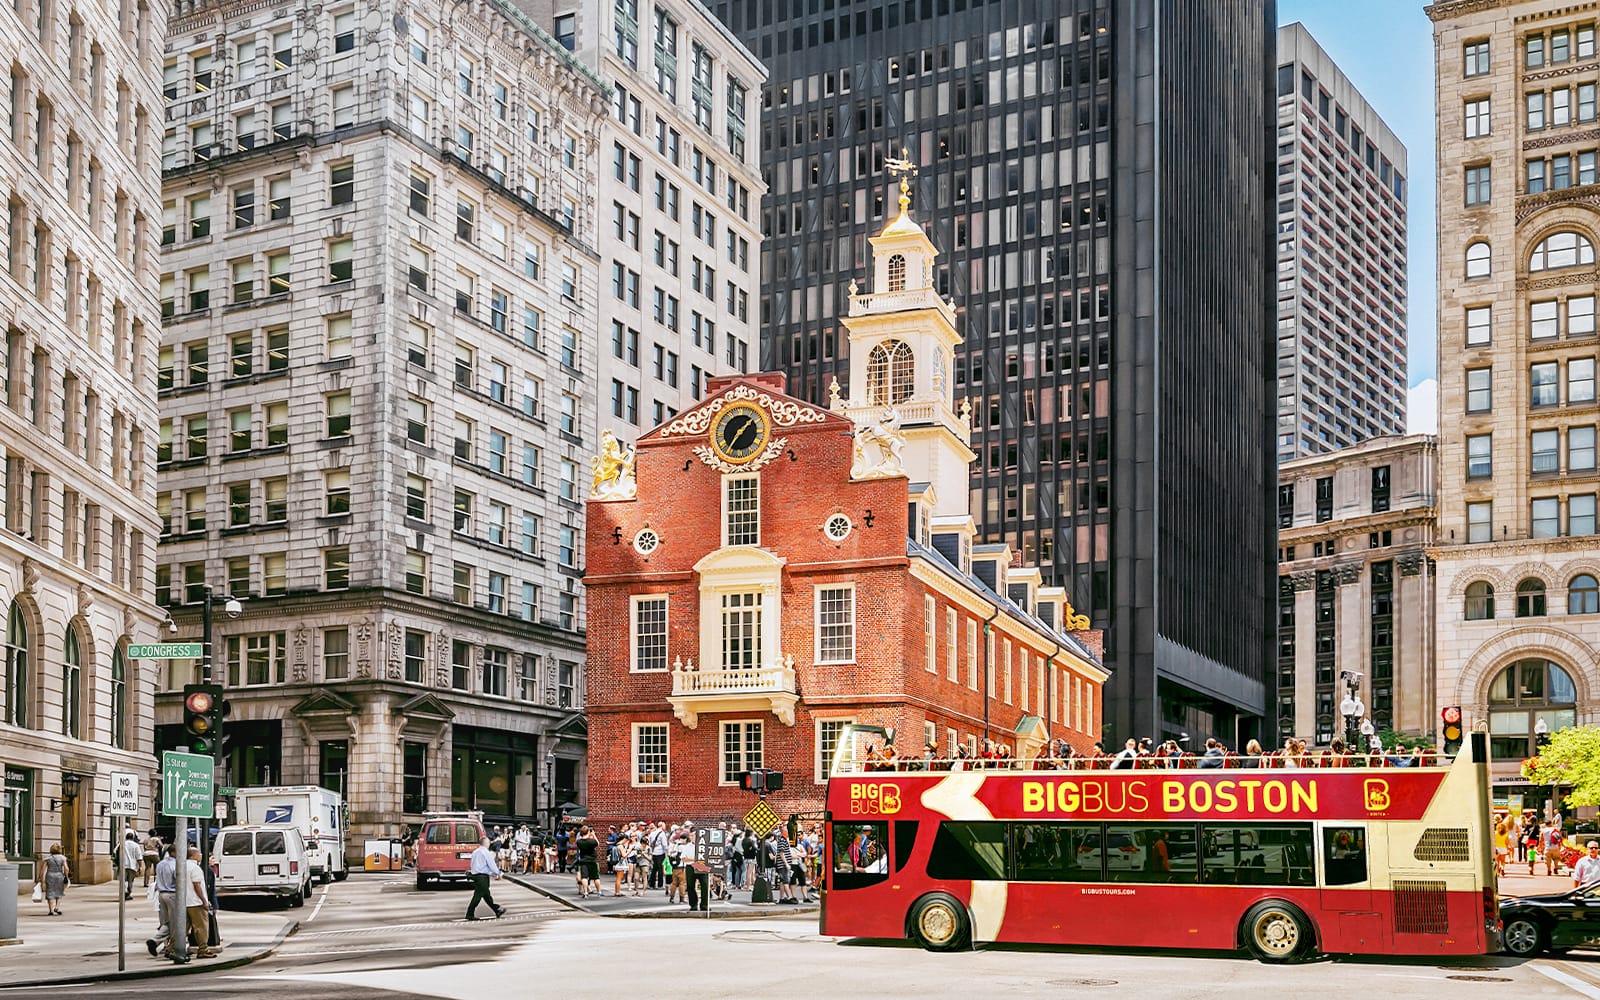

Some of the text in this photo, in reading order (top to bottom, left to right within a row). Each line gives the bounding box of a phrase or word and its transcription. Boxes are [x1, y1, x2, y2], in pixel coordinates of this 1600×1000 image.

[141, 646, 190, 657] CONGRESS
[172, 759, 187, 768] Station
[188, 769, 210, 779] Downtown
[119, 777, 130, 786] NO
[188, 779, 208, 790] Crossing
[117, 789, 133, 798] TURN
[189, 791, 210, 800] Government
[850, 783, 879, 799] BIG
[1162, 780, 1318, 813] BOSTON
[112, 801, 137, 811] ON RED
[189, 801, 203, 809] Center
[850, 799, 879, 815] BUS
[711, 831, 721, 842] P
[698, 829, 706, 861] PARK
